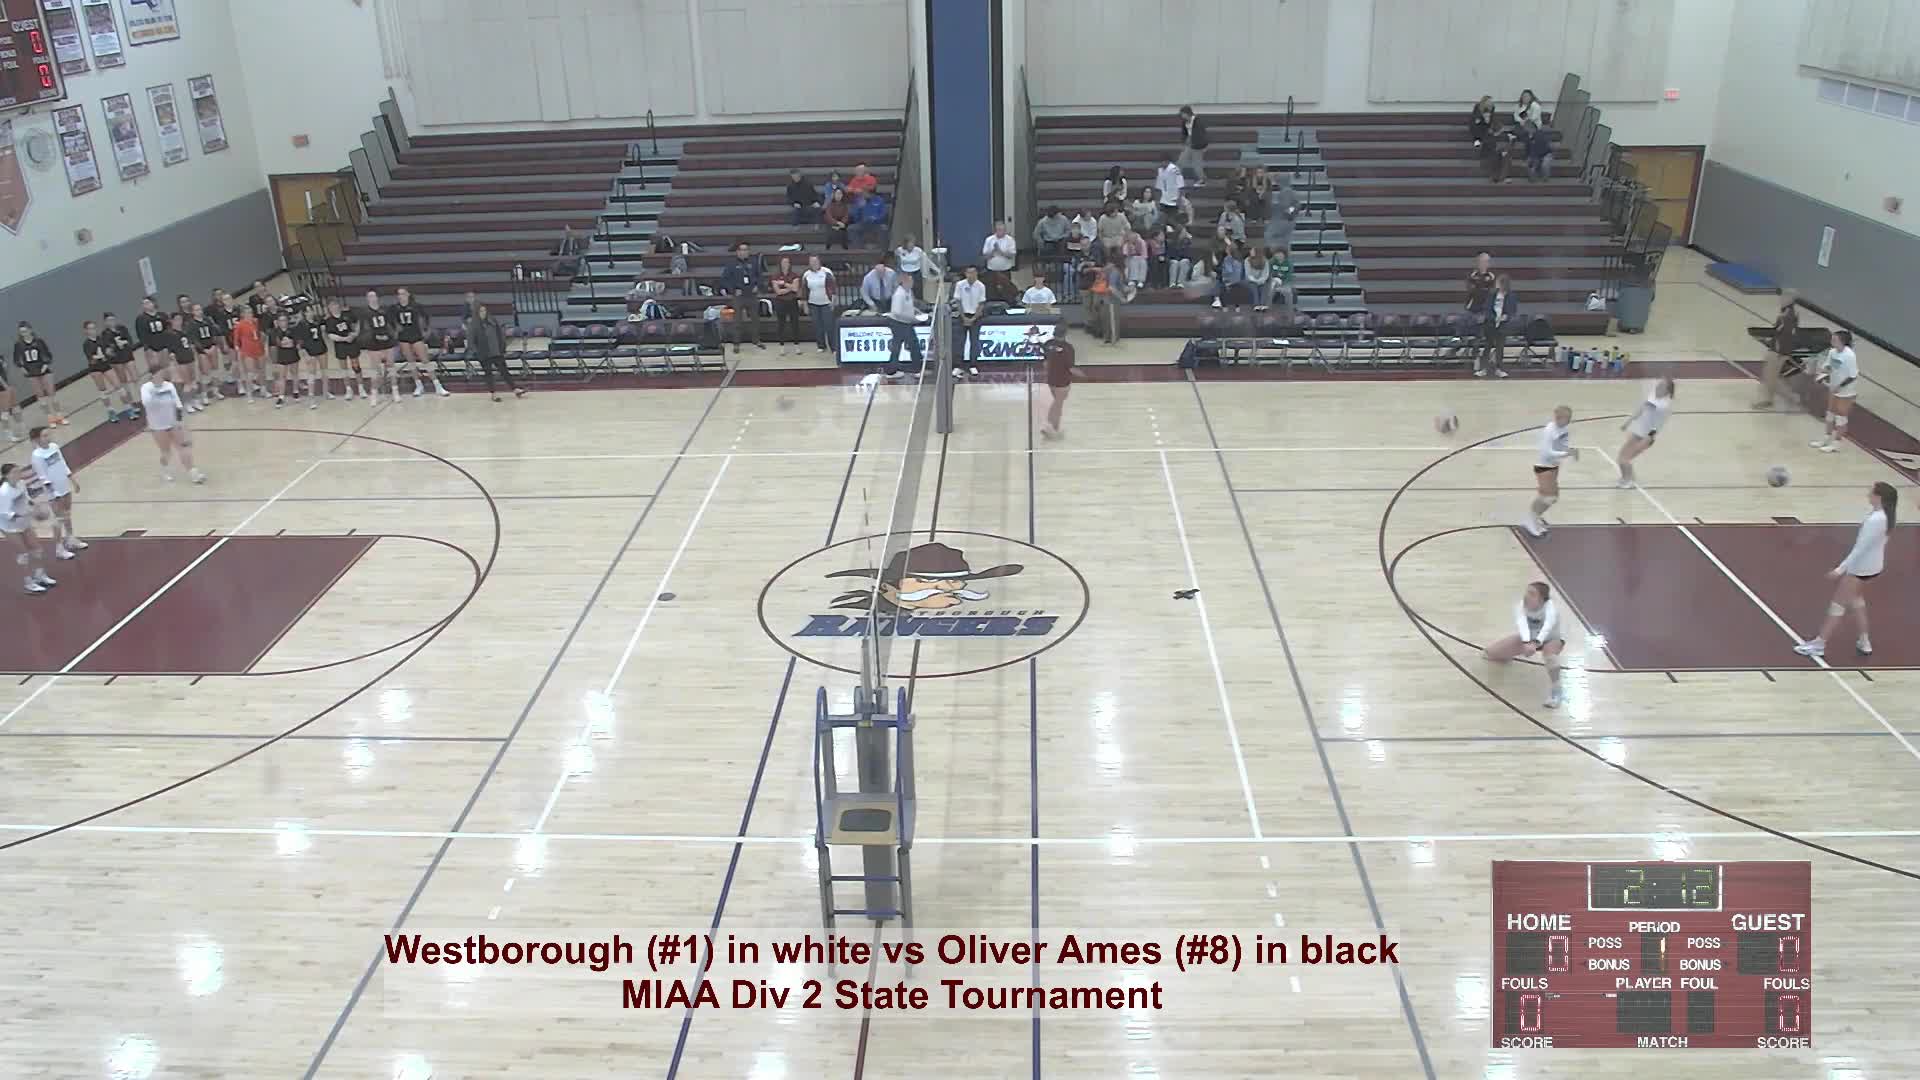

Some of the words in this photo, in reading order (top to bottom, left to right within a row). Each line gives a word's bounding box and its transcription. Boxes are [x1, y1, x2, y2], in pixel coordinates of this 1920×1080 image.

[372, 315, 386, 328] 13
[400, 312, 412, 324] 17
[310, 327, 319, 340] 7
[24, 349, 39, 362] 10
